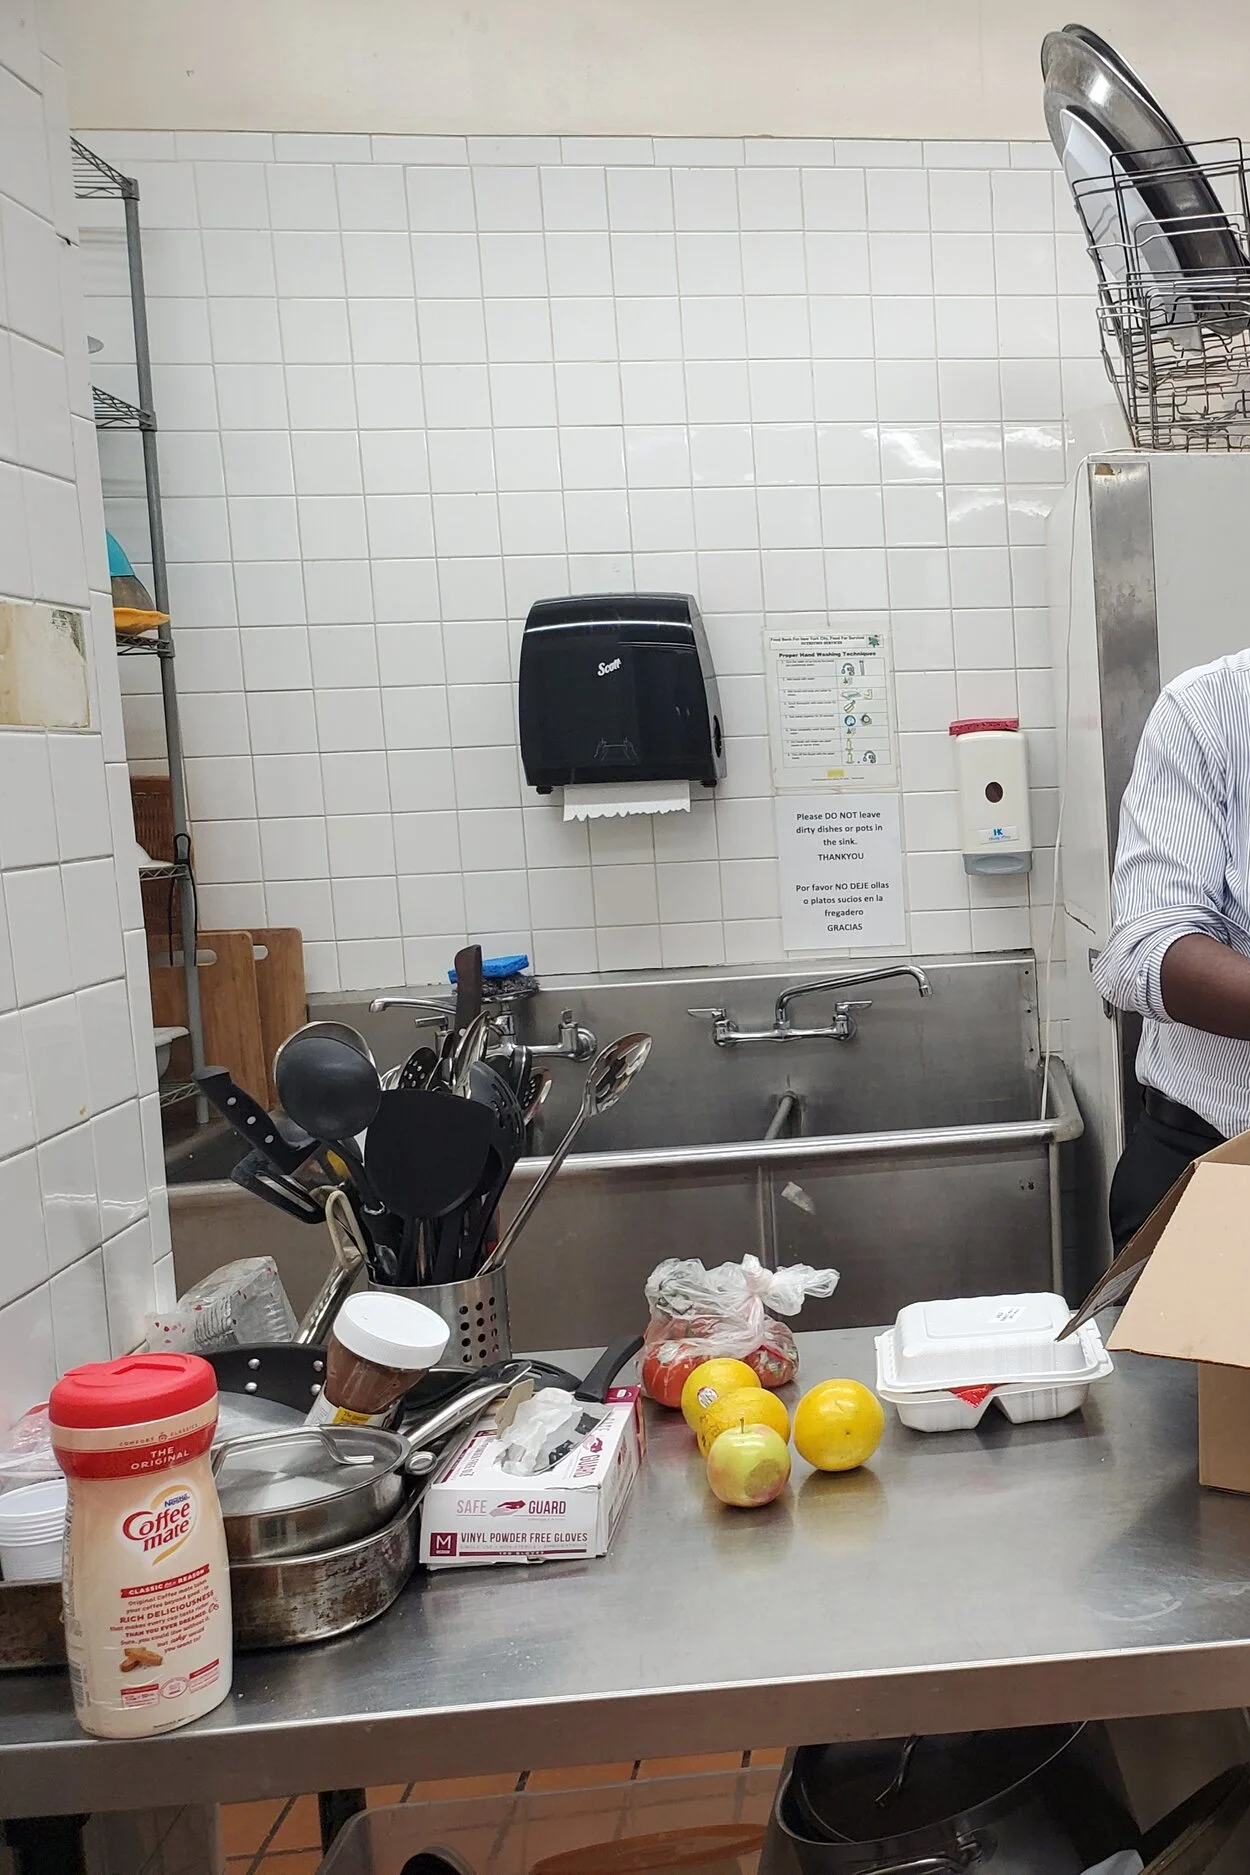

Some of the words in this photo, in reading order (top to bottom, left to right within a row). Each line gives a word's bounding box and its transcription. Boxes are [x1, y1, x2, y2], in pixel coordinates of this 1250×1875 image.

[598, 658, 621, 676] Scott
[797, 813, 822, 821] Please
[856, 825, 873, 833] pots
[818, 853, 864, 861] THANKYOU
[811, 897, 835, 905] platos
[151, 1447, 174, 1458] THE
[131, 1450, 189, 1470] ORIGINAL
[457, 1500, 487, 1514] SAFE
[529, 1501, 566, 1514] GUARD
[123, 1503, 190, 1540] Coffee
[144, 1520, 189, 1552] mate
[436, 1536, 451, 1549] M
[461, 1533, 487, 1542] VINYL
[490, 1533, 527, 1542] POWDER
[530, 1533, 550, 1542] FREE
[554, 1532, 587, 1542] GLOVES
[129, 1584, 163, 1595] CLASSIC
[178, 1569, 204, 1584] REASON
[120, 1615, 144, 1623] RICH
[147, 1590, 214, 1619] DELICIOUSNESS
[125, 1630, 144, 1638] THAN
[161, 1623, 177, 1632] EVER
